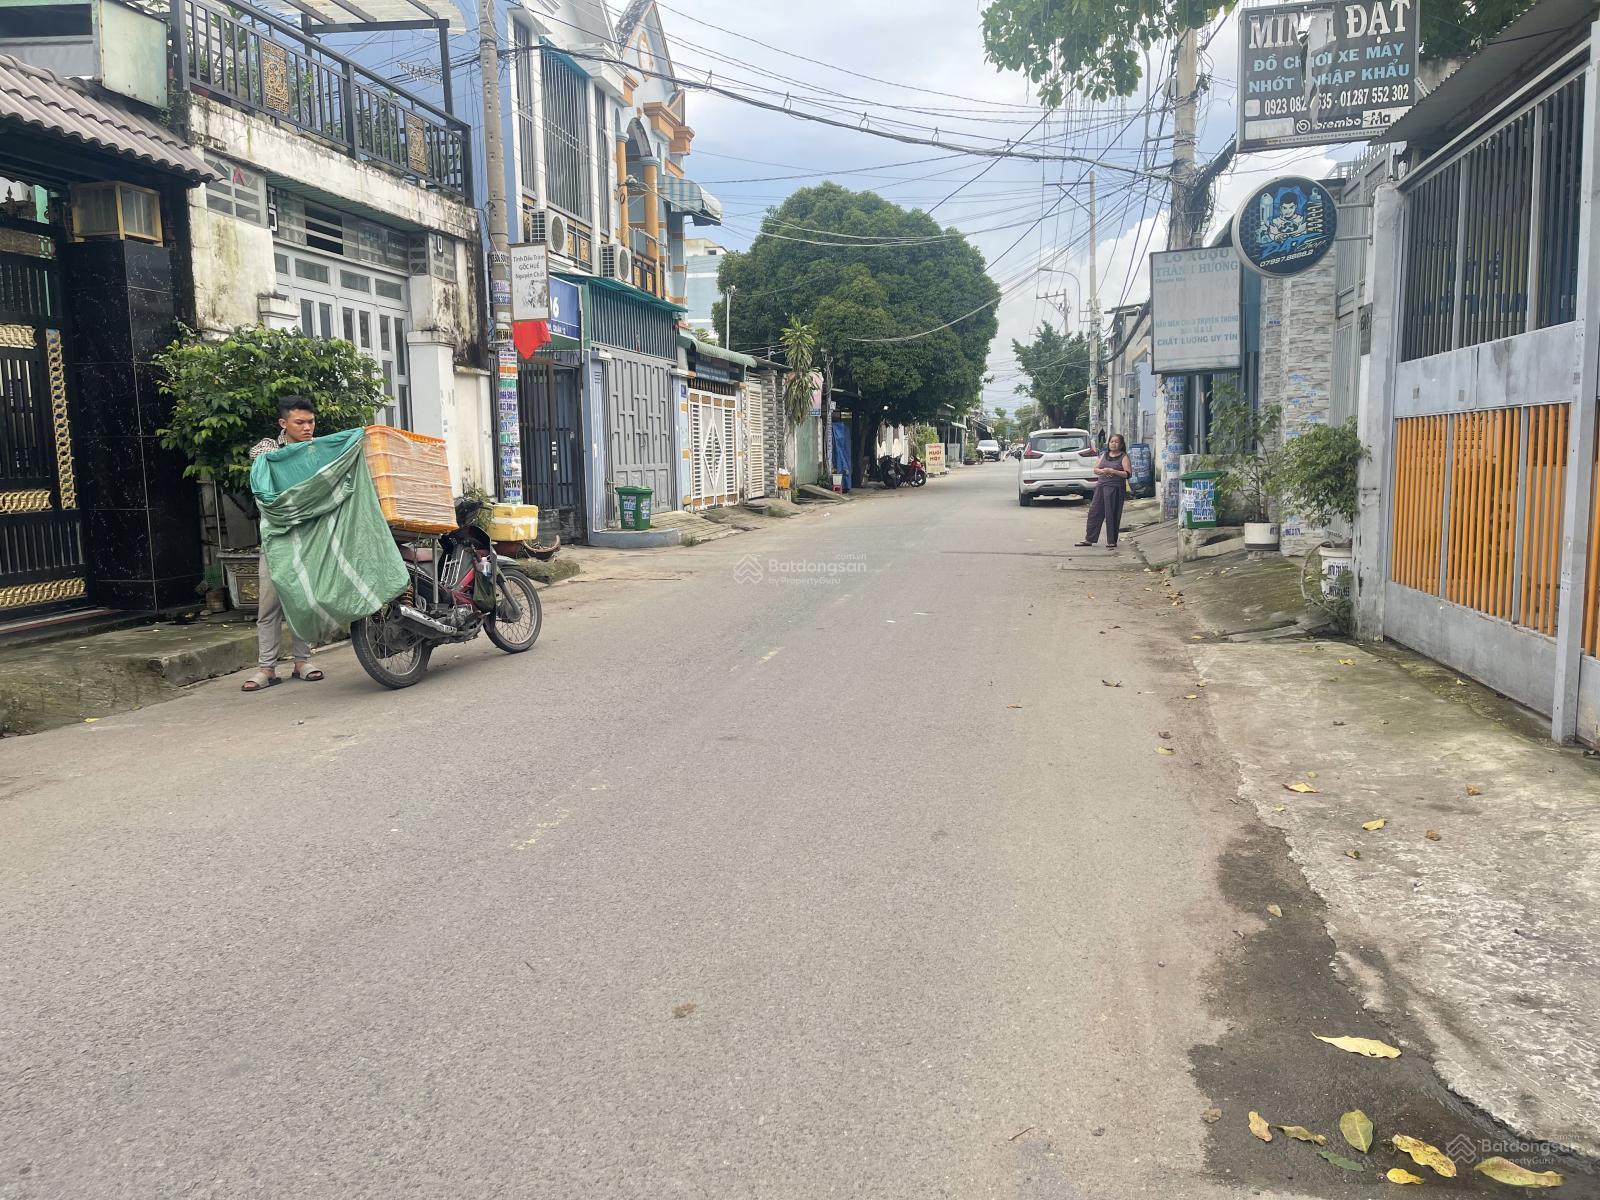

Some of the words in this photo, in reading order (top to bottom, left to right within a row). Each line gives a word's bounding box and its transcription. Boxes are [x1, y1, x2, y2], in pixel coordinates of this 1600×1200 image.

[1345, 0, 1411, 44] ĐẠT
[1253, 54, 1278, 72] ĐỒ
[1338, 48, 1359, 64] XE
[1366, 42, 1404, 60] MÁY
[1248, 75, 1295, 93] NHỚT
[1361, 59, 1410, 81] KHẨU
[1264, 98, 1288, 115] 0923
[1340, 89, 1368, 107] 01287
[1371, 86, 1390, 103] 552
[1392, 83, 1409, 101] 302
